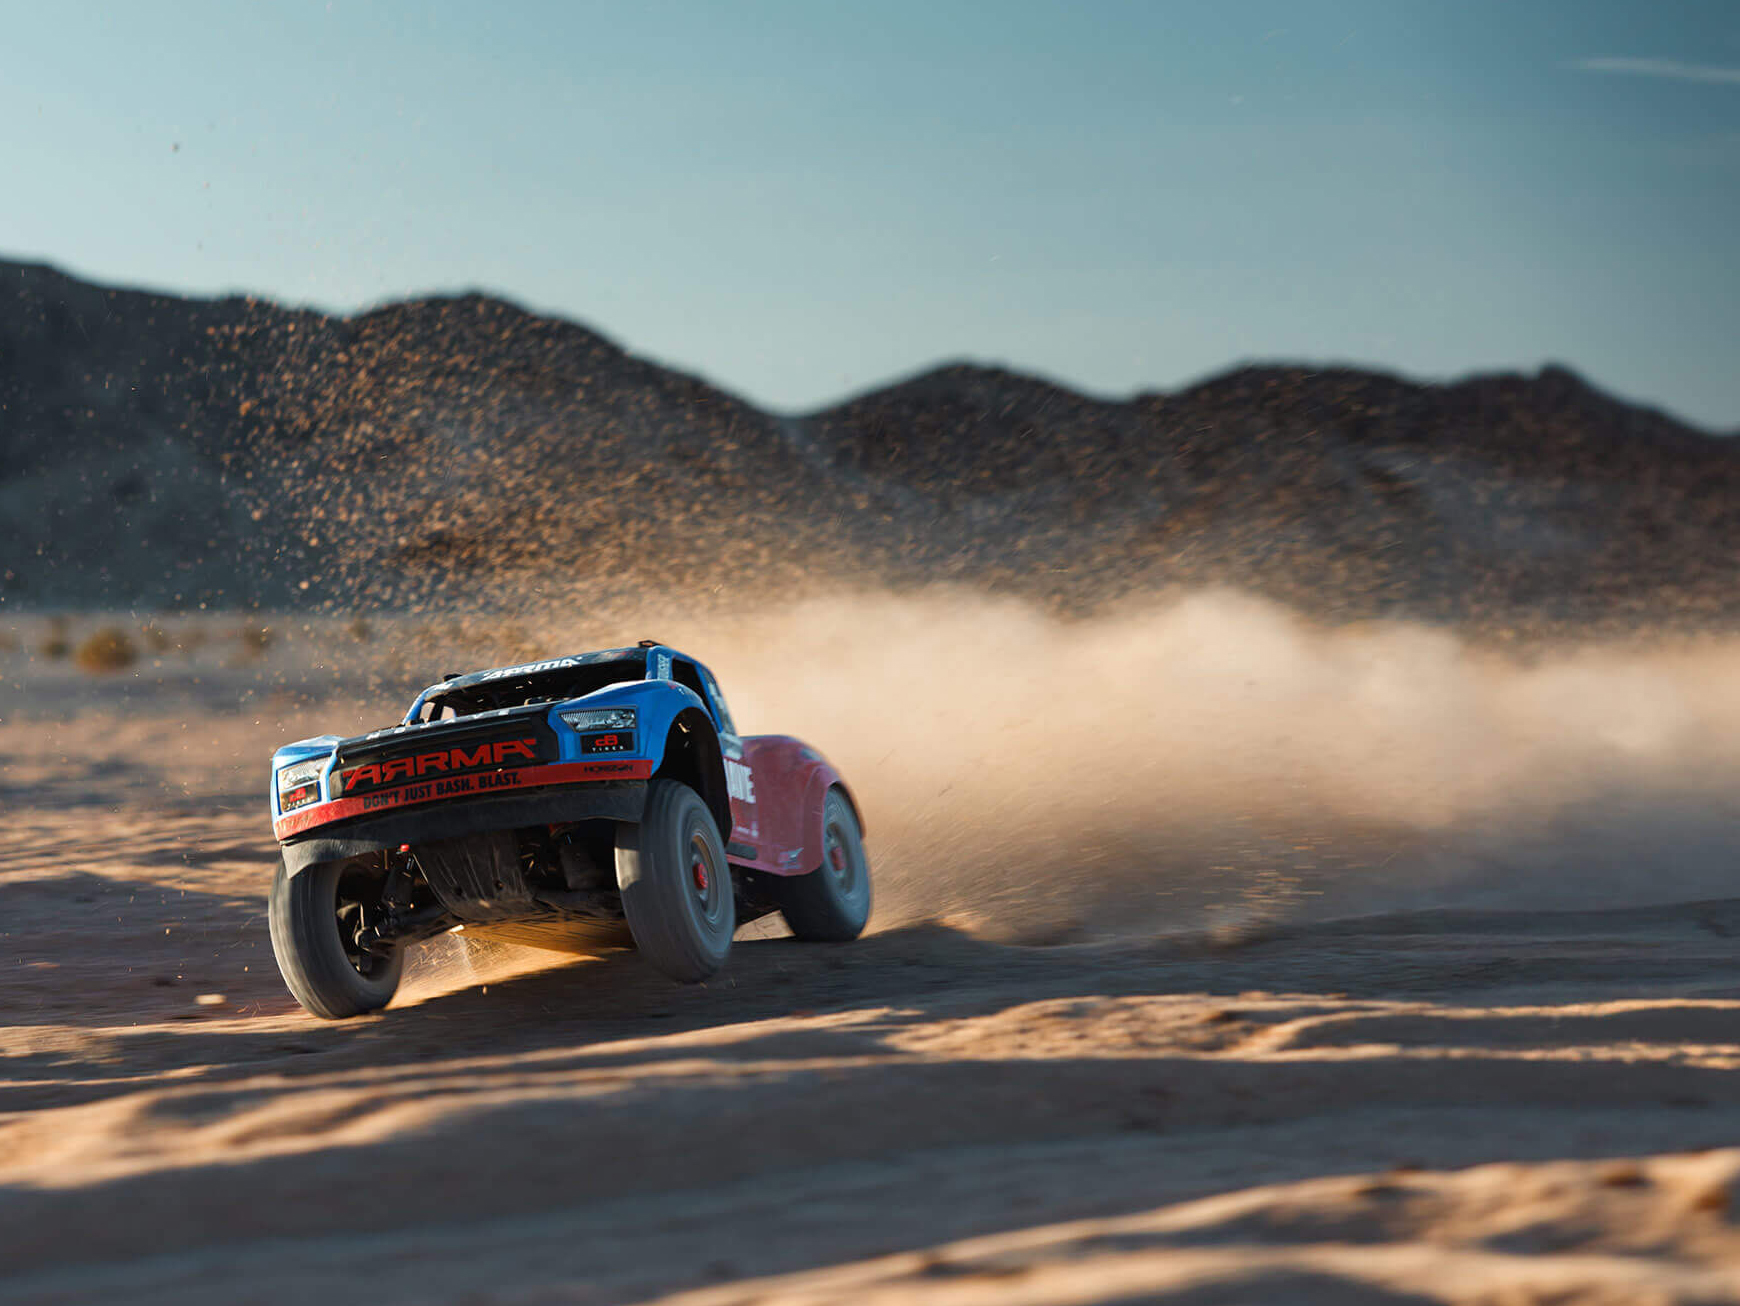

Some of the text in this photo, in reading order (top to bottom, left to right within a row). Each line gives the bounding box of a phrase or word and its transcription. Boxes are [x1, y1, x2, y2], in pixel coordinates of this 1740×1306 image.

[342, 738, 537, 790] ARRMA
[363, 771, 522, 809] DON'T JUST BASH. BLAST.
